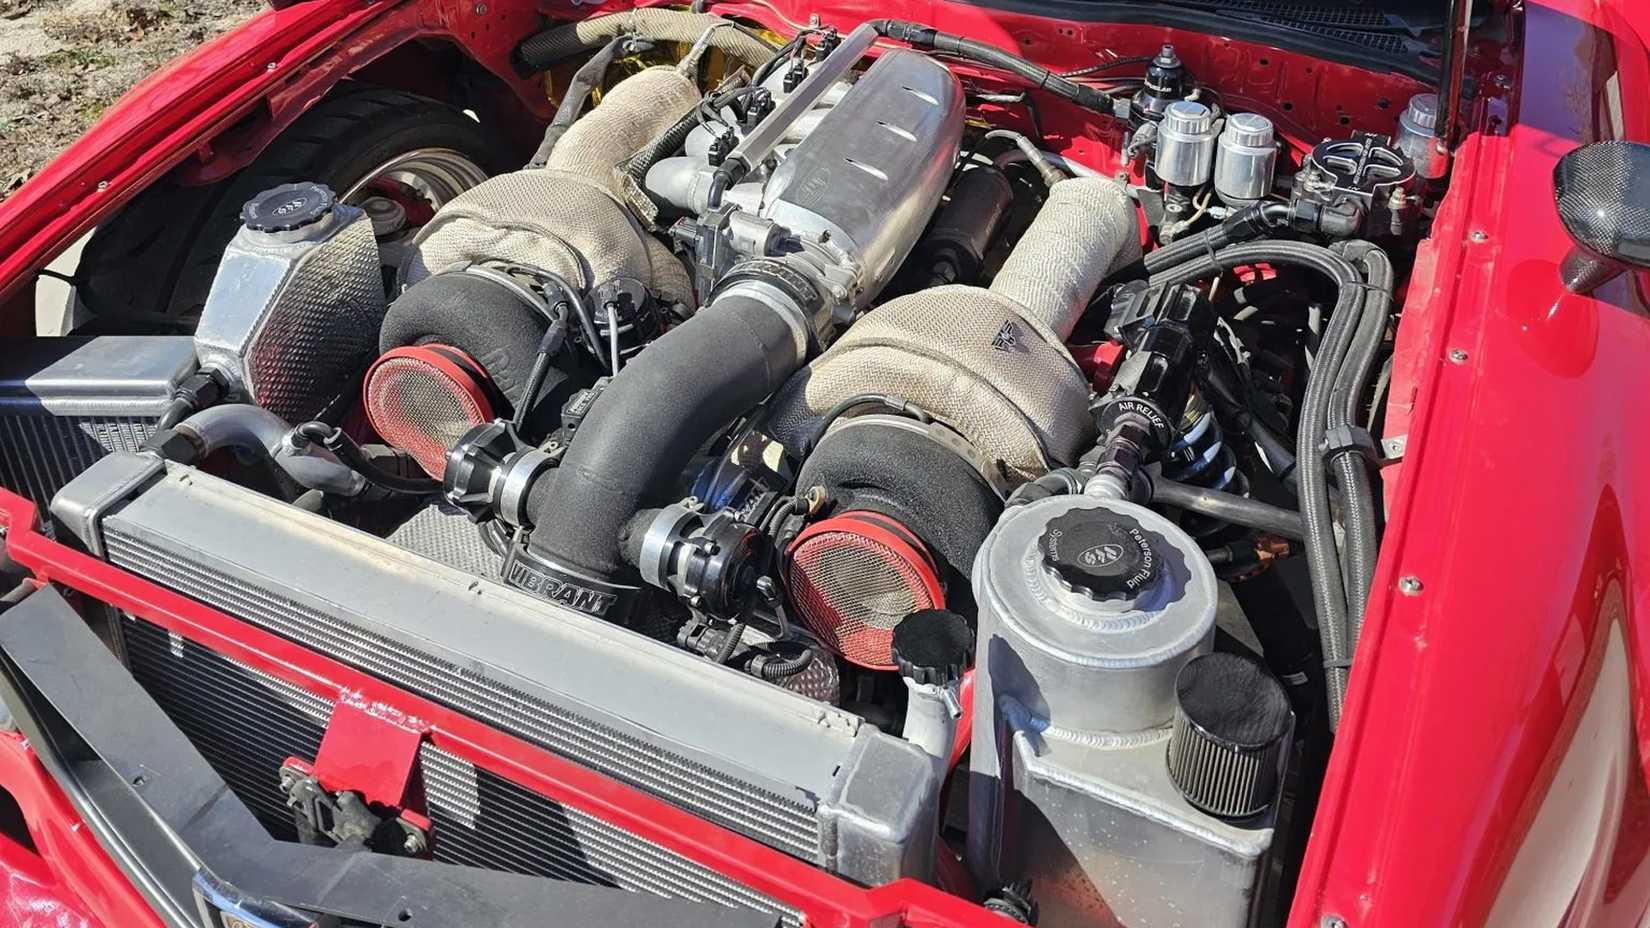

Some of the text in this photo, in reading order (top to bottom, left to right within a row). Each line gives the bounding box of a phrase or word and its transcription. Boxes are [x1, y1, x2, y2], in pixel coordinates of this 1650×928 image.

[1118, 401, 1165, 429] AIR RELIEF
[1126, 528, 1152, 589] Peterson Fluid
[508, 560, 618, 616] VIBRANT
